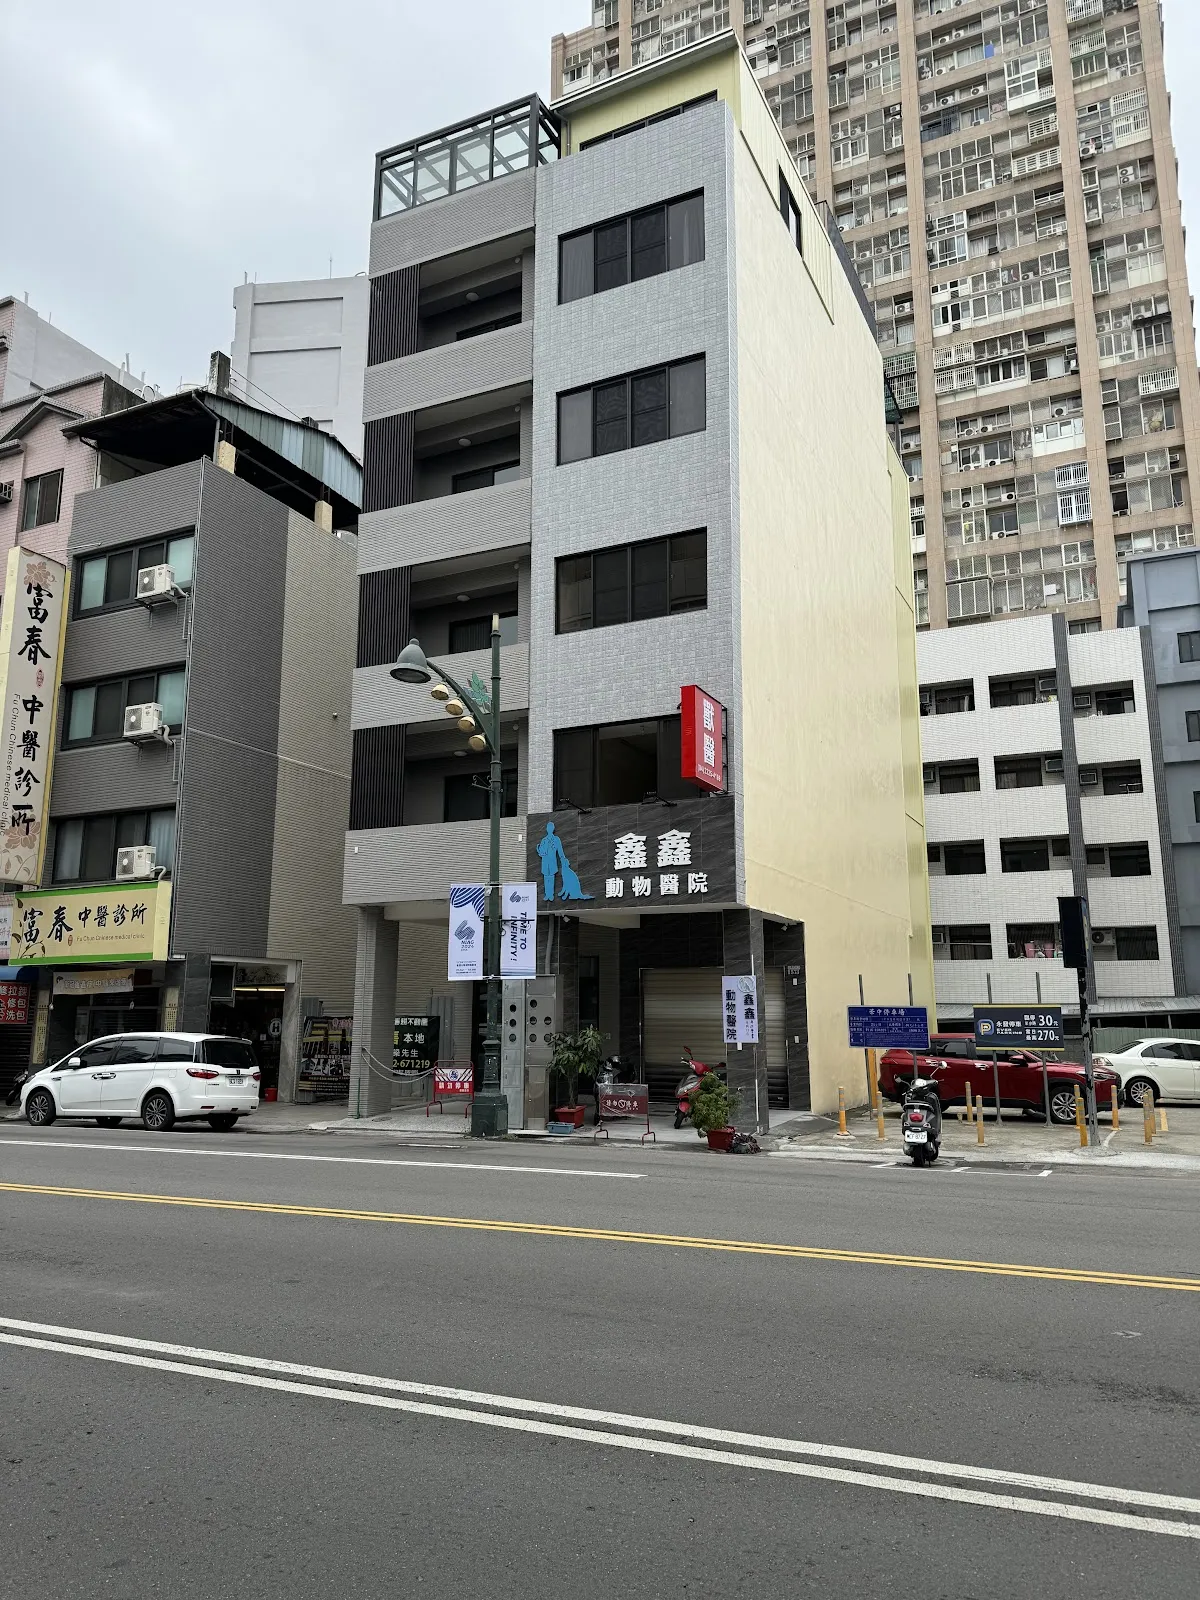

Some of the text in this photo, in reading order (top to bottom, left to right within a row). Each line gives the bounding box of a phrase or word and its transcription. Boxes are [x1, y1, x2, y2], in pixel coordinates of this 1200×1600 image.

[12, 582, 53, 836] 富春 中醫診所
[0, 693, 21, 837] Fu Chun Chinese medical clinic
[614, 828, 692, 870] 鑫鑫
[605, 872, 708, 898] 動物醫院
[23, 903, 148, 943] 富春 中醫診所
[519, 937, 527, 950] TO
[725, 989, 737, 1040] 動物醫院
[403, 1032, 425, 1044] 本地
